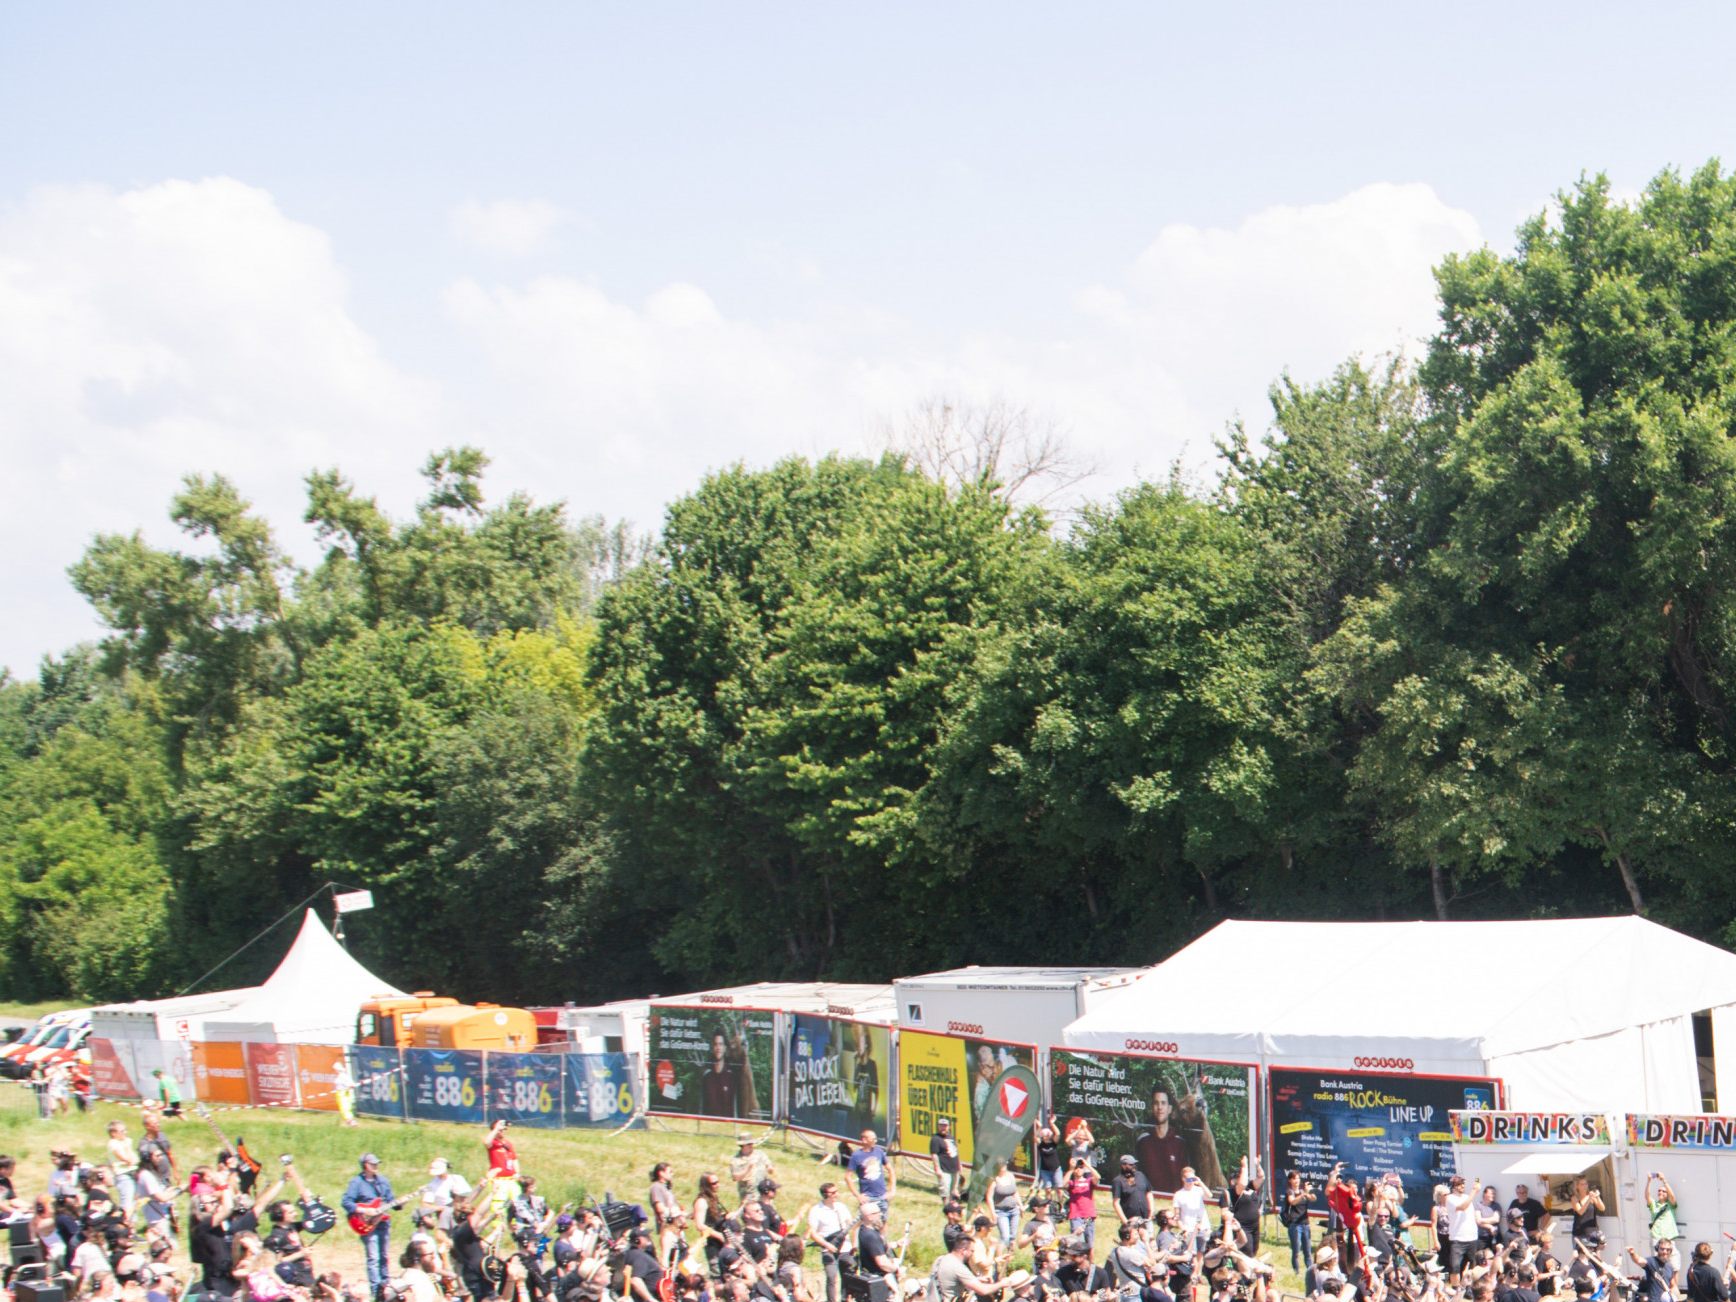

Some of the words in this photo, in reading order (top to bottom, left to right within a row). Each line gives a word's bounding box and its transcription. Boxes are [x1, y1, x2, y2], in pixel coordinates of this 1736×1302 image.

[795, 1061, 807, 1082] SO
[808, 1055, 839, 1081] ROCKT
[908, 1063, 958, 1085] FLASCHENHALS
[1069, 1064, 1082, 1076] Die
[1083, 1065, 1105, 1078] Natur
[435, 1076, 476, 1107] 886
[1069, 1078, 1081, 1090] Sie
[1083, 1079, 1104, 1092] dafür
[1320, 1079, 1337, 1089] Bank
[1338, 1081, 1363, 1091] Austria
[513, 1081, 552, 1113] 886
[590, 1082, 634, 1114] 886
[795, 1084, 814, 1109] DAS
[908, 1083, 928, 1107] ÜBER
[929, 1083, 958, 1115] KOPF
[1069, 1092, 1083, 1103] das
[1085, 1092, 1146, 1110] GoGreen-Konto
[1313, 1091, 1333, 1101] radio
[1334, 1092, 1349, 1102] 886
[1349, 1090, 1385, 1109] ROCK
[1465, 1099, 1489, 1110] 886
[1390, 1106, 1417, 1122] LINE
[1419, 1104, 1434, 1123] UP
[1469, 1116, 1596, 1141] DRINKS
